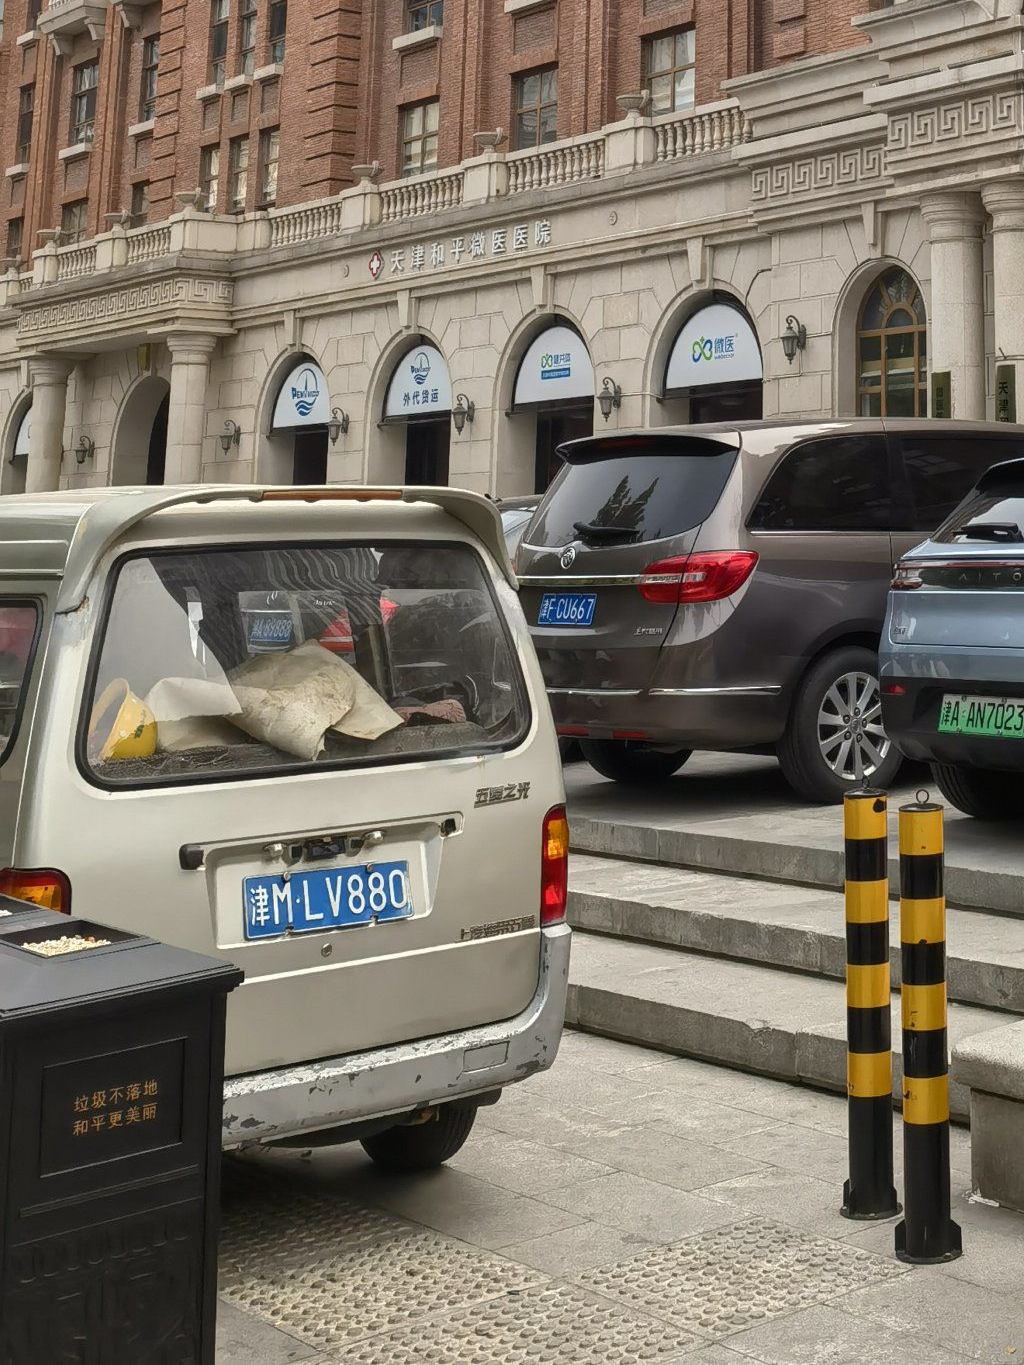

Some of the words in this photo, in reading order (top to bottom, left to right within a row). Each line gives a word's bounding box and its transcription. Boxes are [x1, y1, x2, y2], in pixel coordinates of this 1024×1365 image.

[390, 219, 552, 273] 天津和平微医医院
[714, 335, 734, 354] 微医
[403, 389, 439, 407] 外代货运
[73, 1078, 158, 1112] 垃圾不落地
[72, 1102, 158, 1136] 和平更美丽
